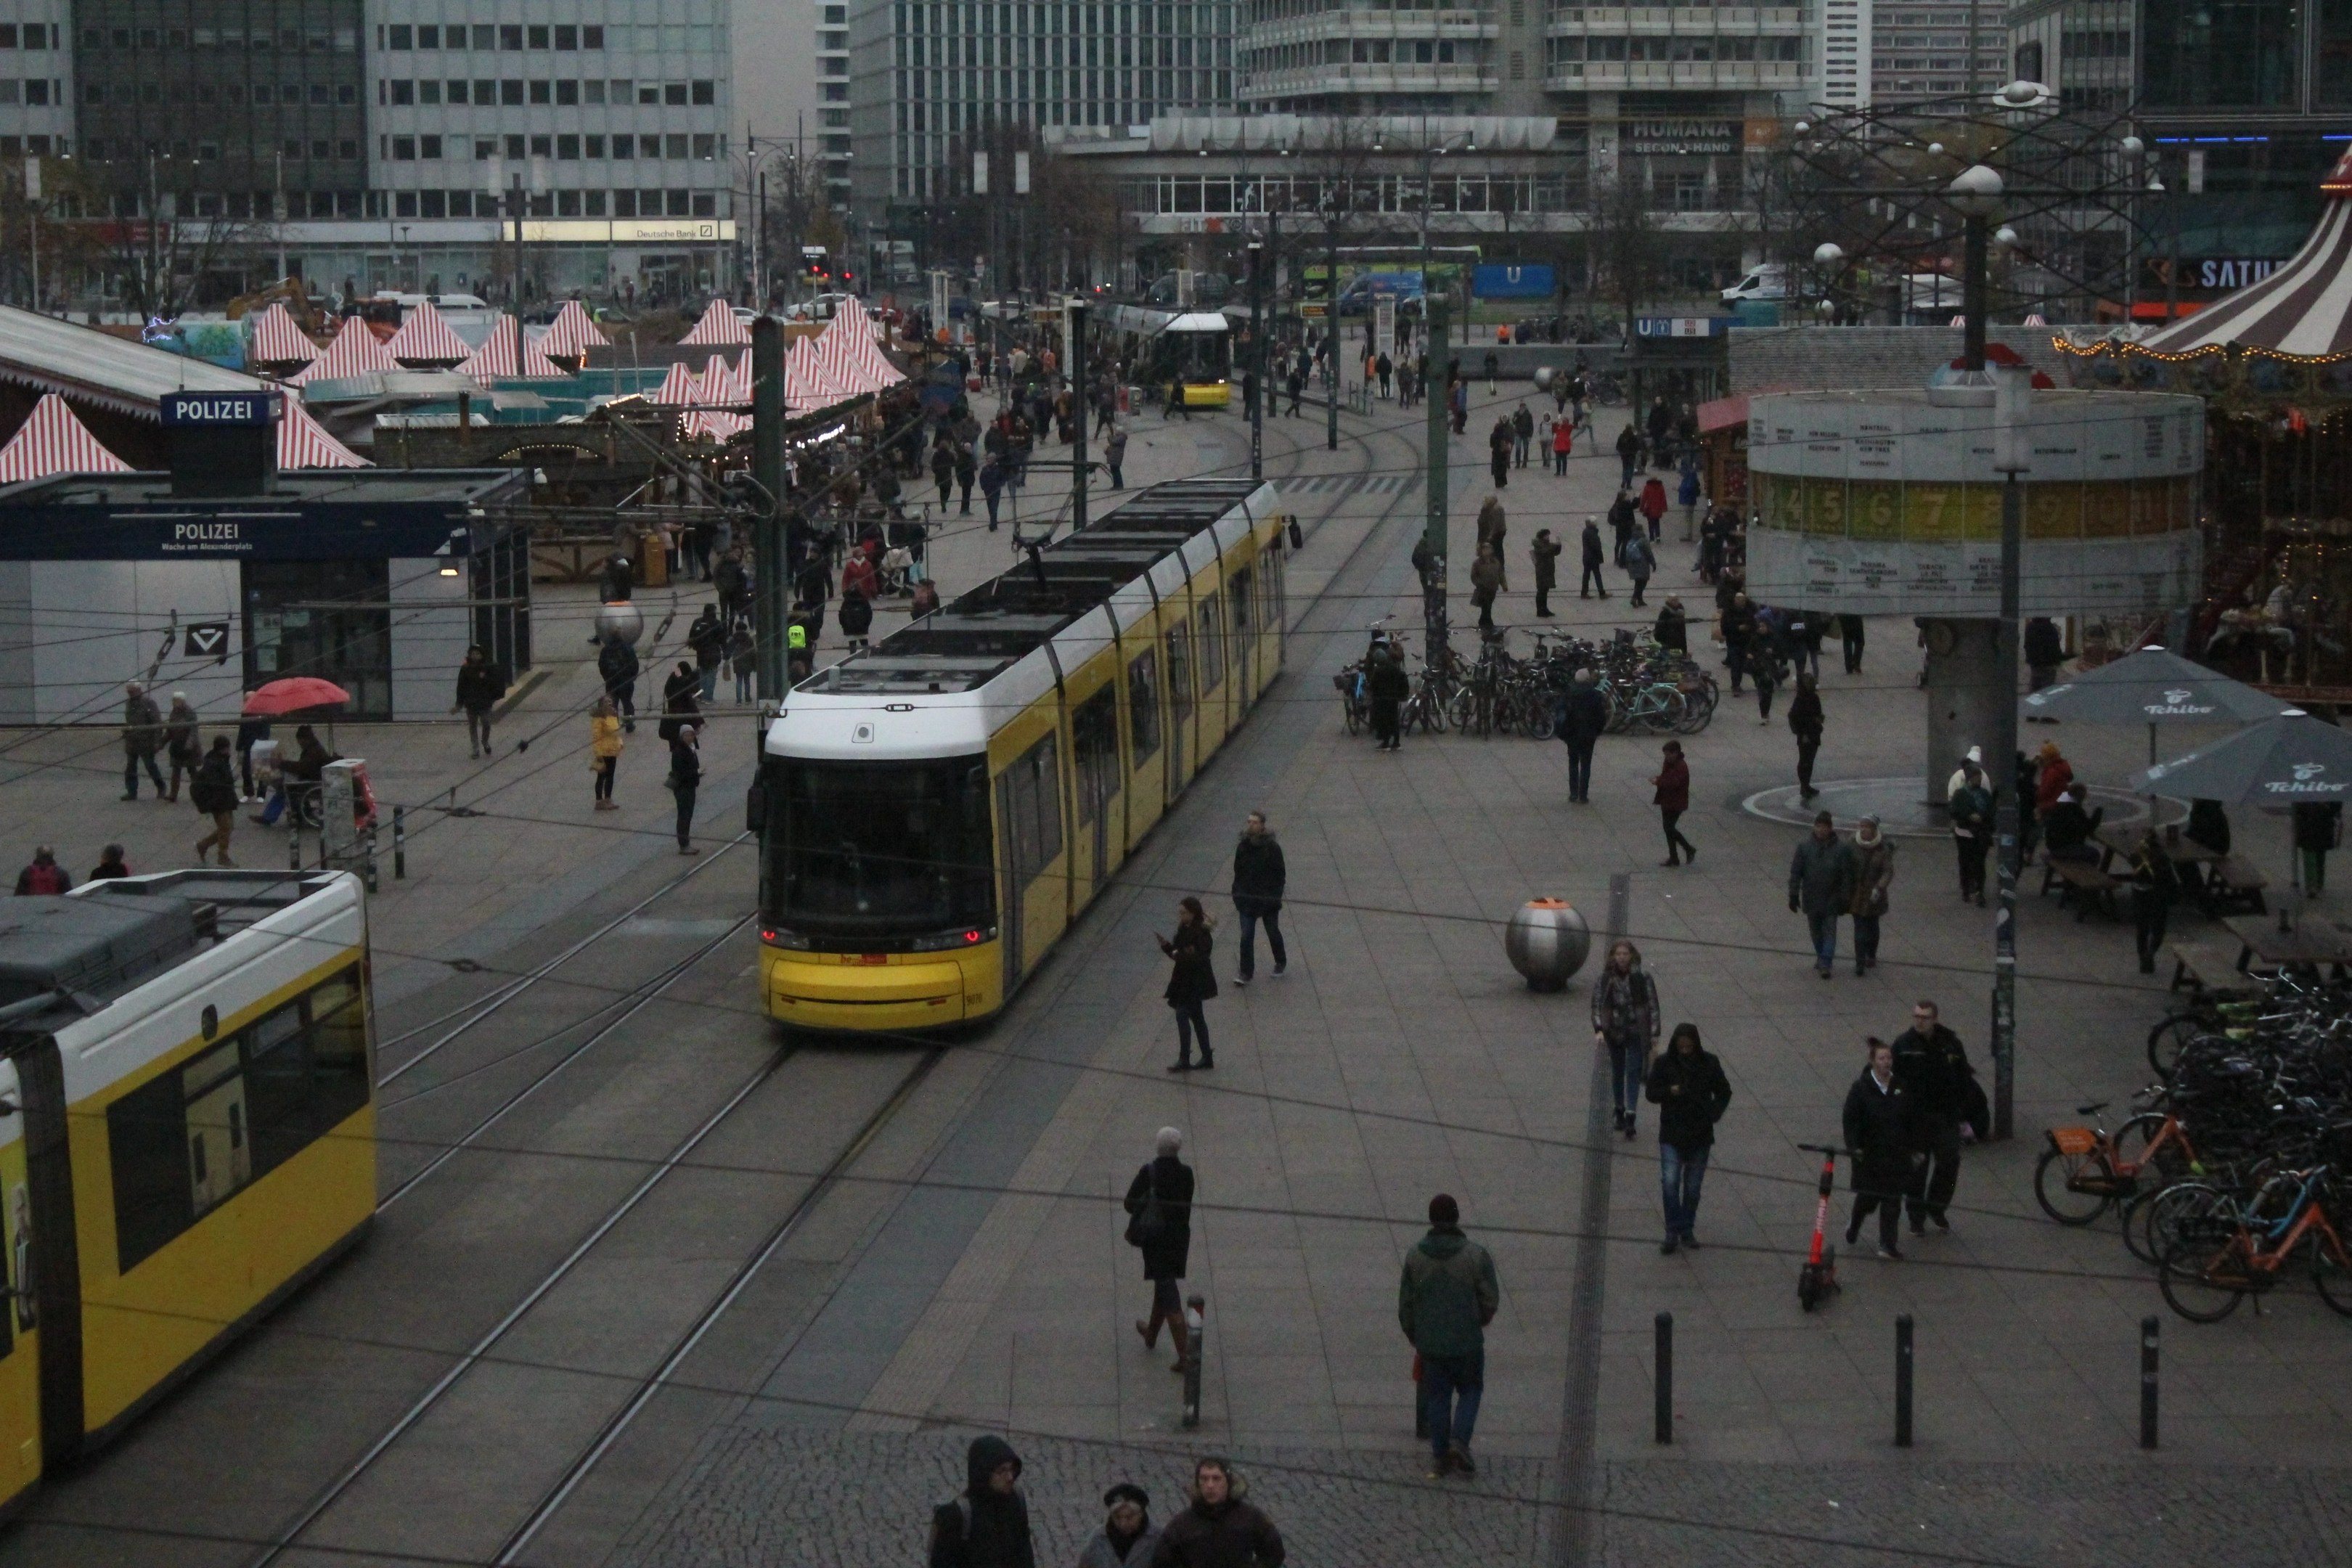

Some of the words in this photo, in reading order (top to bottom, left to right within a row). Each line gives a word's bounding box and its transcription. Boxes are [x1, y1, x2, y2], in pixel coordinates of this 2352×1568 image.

[1633, 122, 1731, 138] HUMANA
[1506, 266, 1521, 284] U
[2201, 260, 2287, 287] SATU
[1638, 319, 1651, 335] U
[176, 401, 252, 420] POLIZEI
[1824, 491, 1842, 523] 5
[1869, 493, 1893, 526] 6
[1918, 494, 1949, 526] 7
[2036, 494, 2062, 525] 9
[175, 523, 239, 539] POLIZEI
[200, 542, 253, 552] Alexanderplatz
[2143, 704, 2216, 715] Tchibo
[2264, 780, 2350, 793] Tchibo
